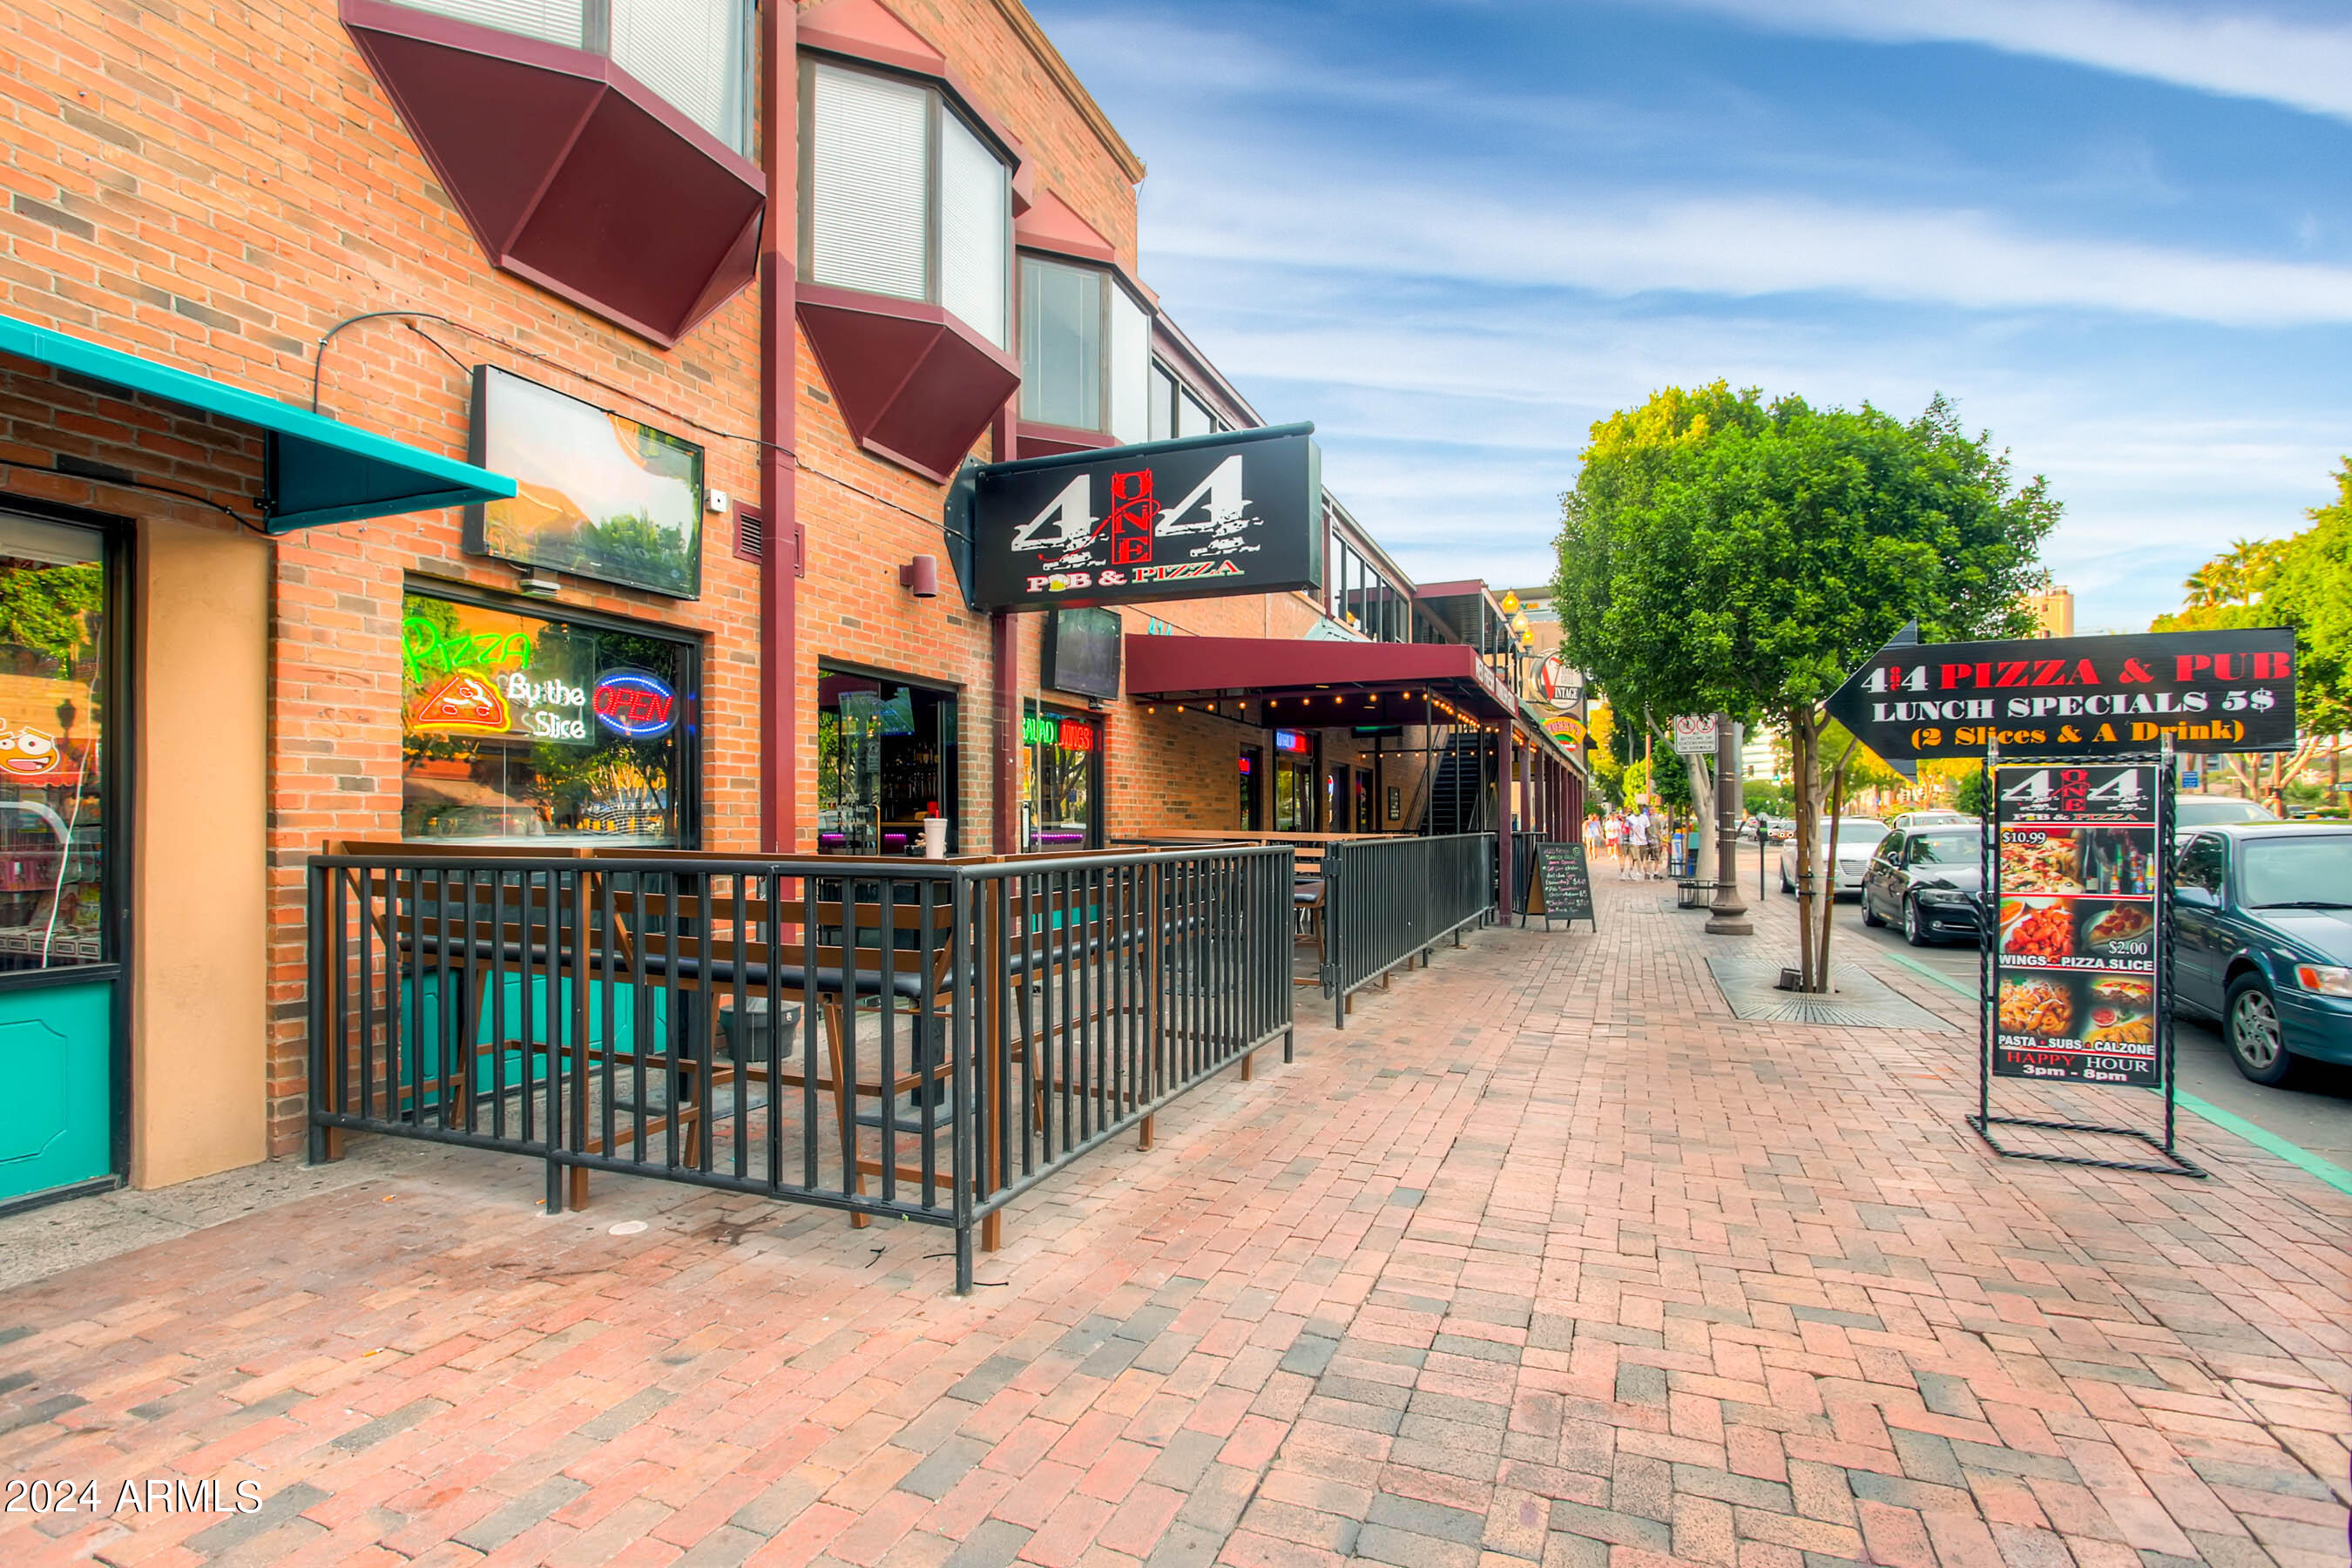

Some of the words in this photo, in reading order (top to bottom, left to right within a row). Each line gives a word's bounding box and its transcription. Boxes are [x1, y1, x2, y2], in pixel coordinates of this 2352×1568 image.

[1011, 474, 1106, 571] 4
[1112, 468, 1153, 564] ONE
[1155, 455, 1264, 557] 4
[1098, 569, 1127, 586] &
[1132, 559, 1245, 584] PIZZA
[1861, 667, 1888, 693] 4
[1901, 666, 1929, 692] 4
[1938, 659, 2102, 690] PIZZA
[2119, 657, 2154, 684] &
[2174, 652, 2292, 681] PUB
[546, 679, 586, 706] the
[593, 686, 673, 723] OPEN
[1872, 700, 1995, 722] LUNCH
[2007, 692, 2209, 718] SPECIALS
[2221, 687, 2276, 713] 5$
[533, 710, 586, 740] Slice
[1911, 727, 1943, 750] (2
[1955, 726, 2046, 746] Slices
[2057, 724, 2083, 743] &
[2092, 723, 2118, 742] A
[2131, 720, 2246, 743] Drink)
[2001, 769, 2059, 811] 4
[2061, 768, 2089, 811] ONE
[2087, 768, 2148, 811] 4
[2002, 831, 2046, 844] $10.99
[2109, 941, 2147, 955] $2.00
[1999, 955, 2047, 965] WINGS
[2061, 956, 2105, 969] PIZZA
[2109, 959, 2153, 971] SLICE
[1998, 1035, 2036, 1046] PASTA
[2048, 1038, 2082, 1050] SUBS
[2094, 1041, 2154, 1055] CALZONE
[2006, 1051, 2076, 1066] HAPPY
[2086, 1057, 2149, 1072] HOUR
[2023, 1064, 2065, 1077] 3pm
[2083, 1069, 2127, 1082] 8pm
